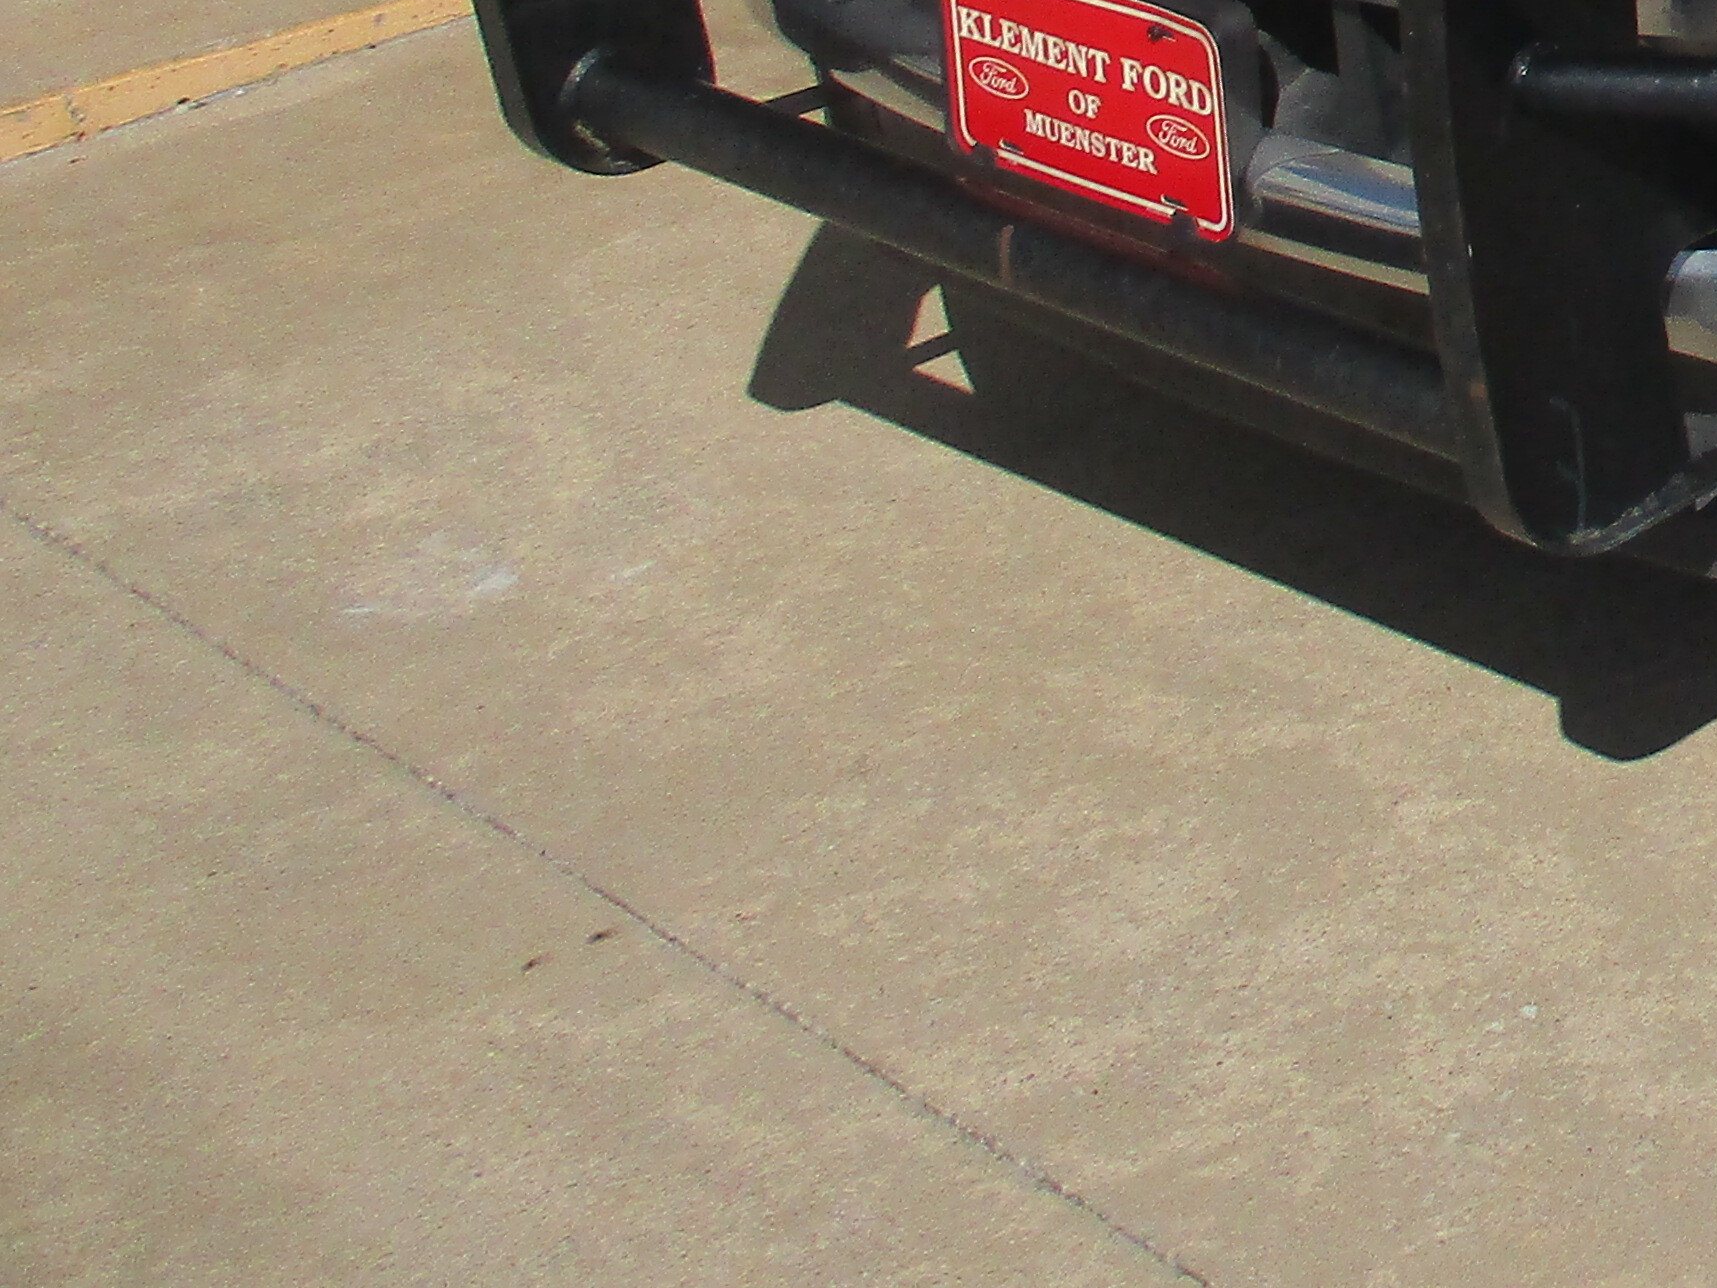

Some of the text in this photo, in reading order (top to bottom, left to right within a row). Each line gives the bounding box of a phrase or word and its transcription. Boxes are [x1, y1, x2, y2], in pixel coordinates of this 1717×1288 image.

[957, 5, 1213, 116] KLEMENT FORD
[978, 60, 1019, 95] Ford
[1067, 89, 1101, 119] OF
[1023, 108, 1158, 175] MUENSTER
[1158, 119, 1198, 154] Ford
